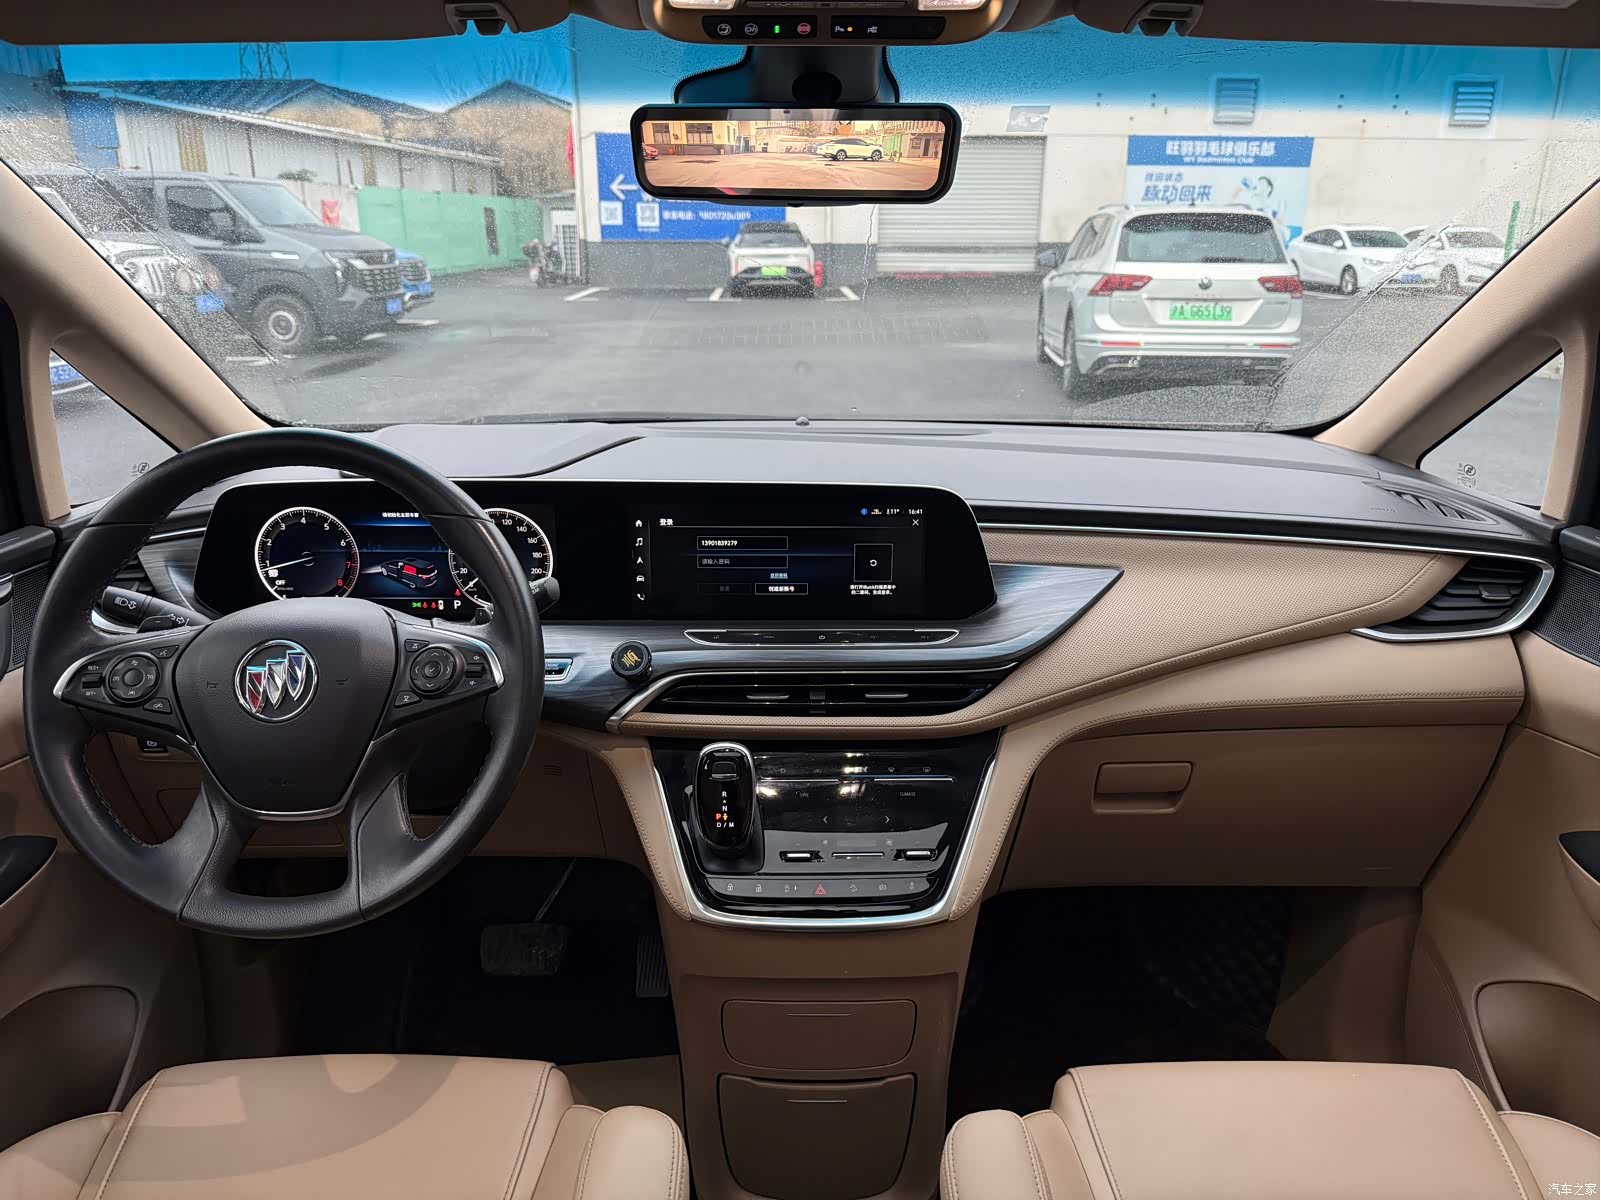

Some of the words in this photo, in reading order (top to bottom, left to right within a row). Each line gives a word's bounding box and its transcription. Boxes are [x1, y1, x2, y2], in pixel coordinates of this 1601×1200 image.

[1197, 156, 1236, 164] Badminton
[1238, 156, 1254, 165] Club
[300, 517, 307, 525] 4
[660, 518, 674, 526] 登录
[280, 523, 287, 531] 3
[324, 523, 330, 531] 5
[516, 525, 528, 533] 140
[267, 538, 273, 546] 2
[340, 539, 347, 547] 6
[532, 551, 543, 559] 180
[346, 561, 351, 569] 7
[459, 567, 468, 575] 20
[530, 567, 543, 575] 200
[337, 578, 344, 587] 8
[453, 600, 461, 610] P
[721, 790, 728, 798] R
